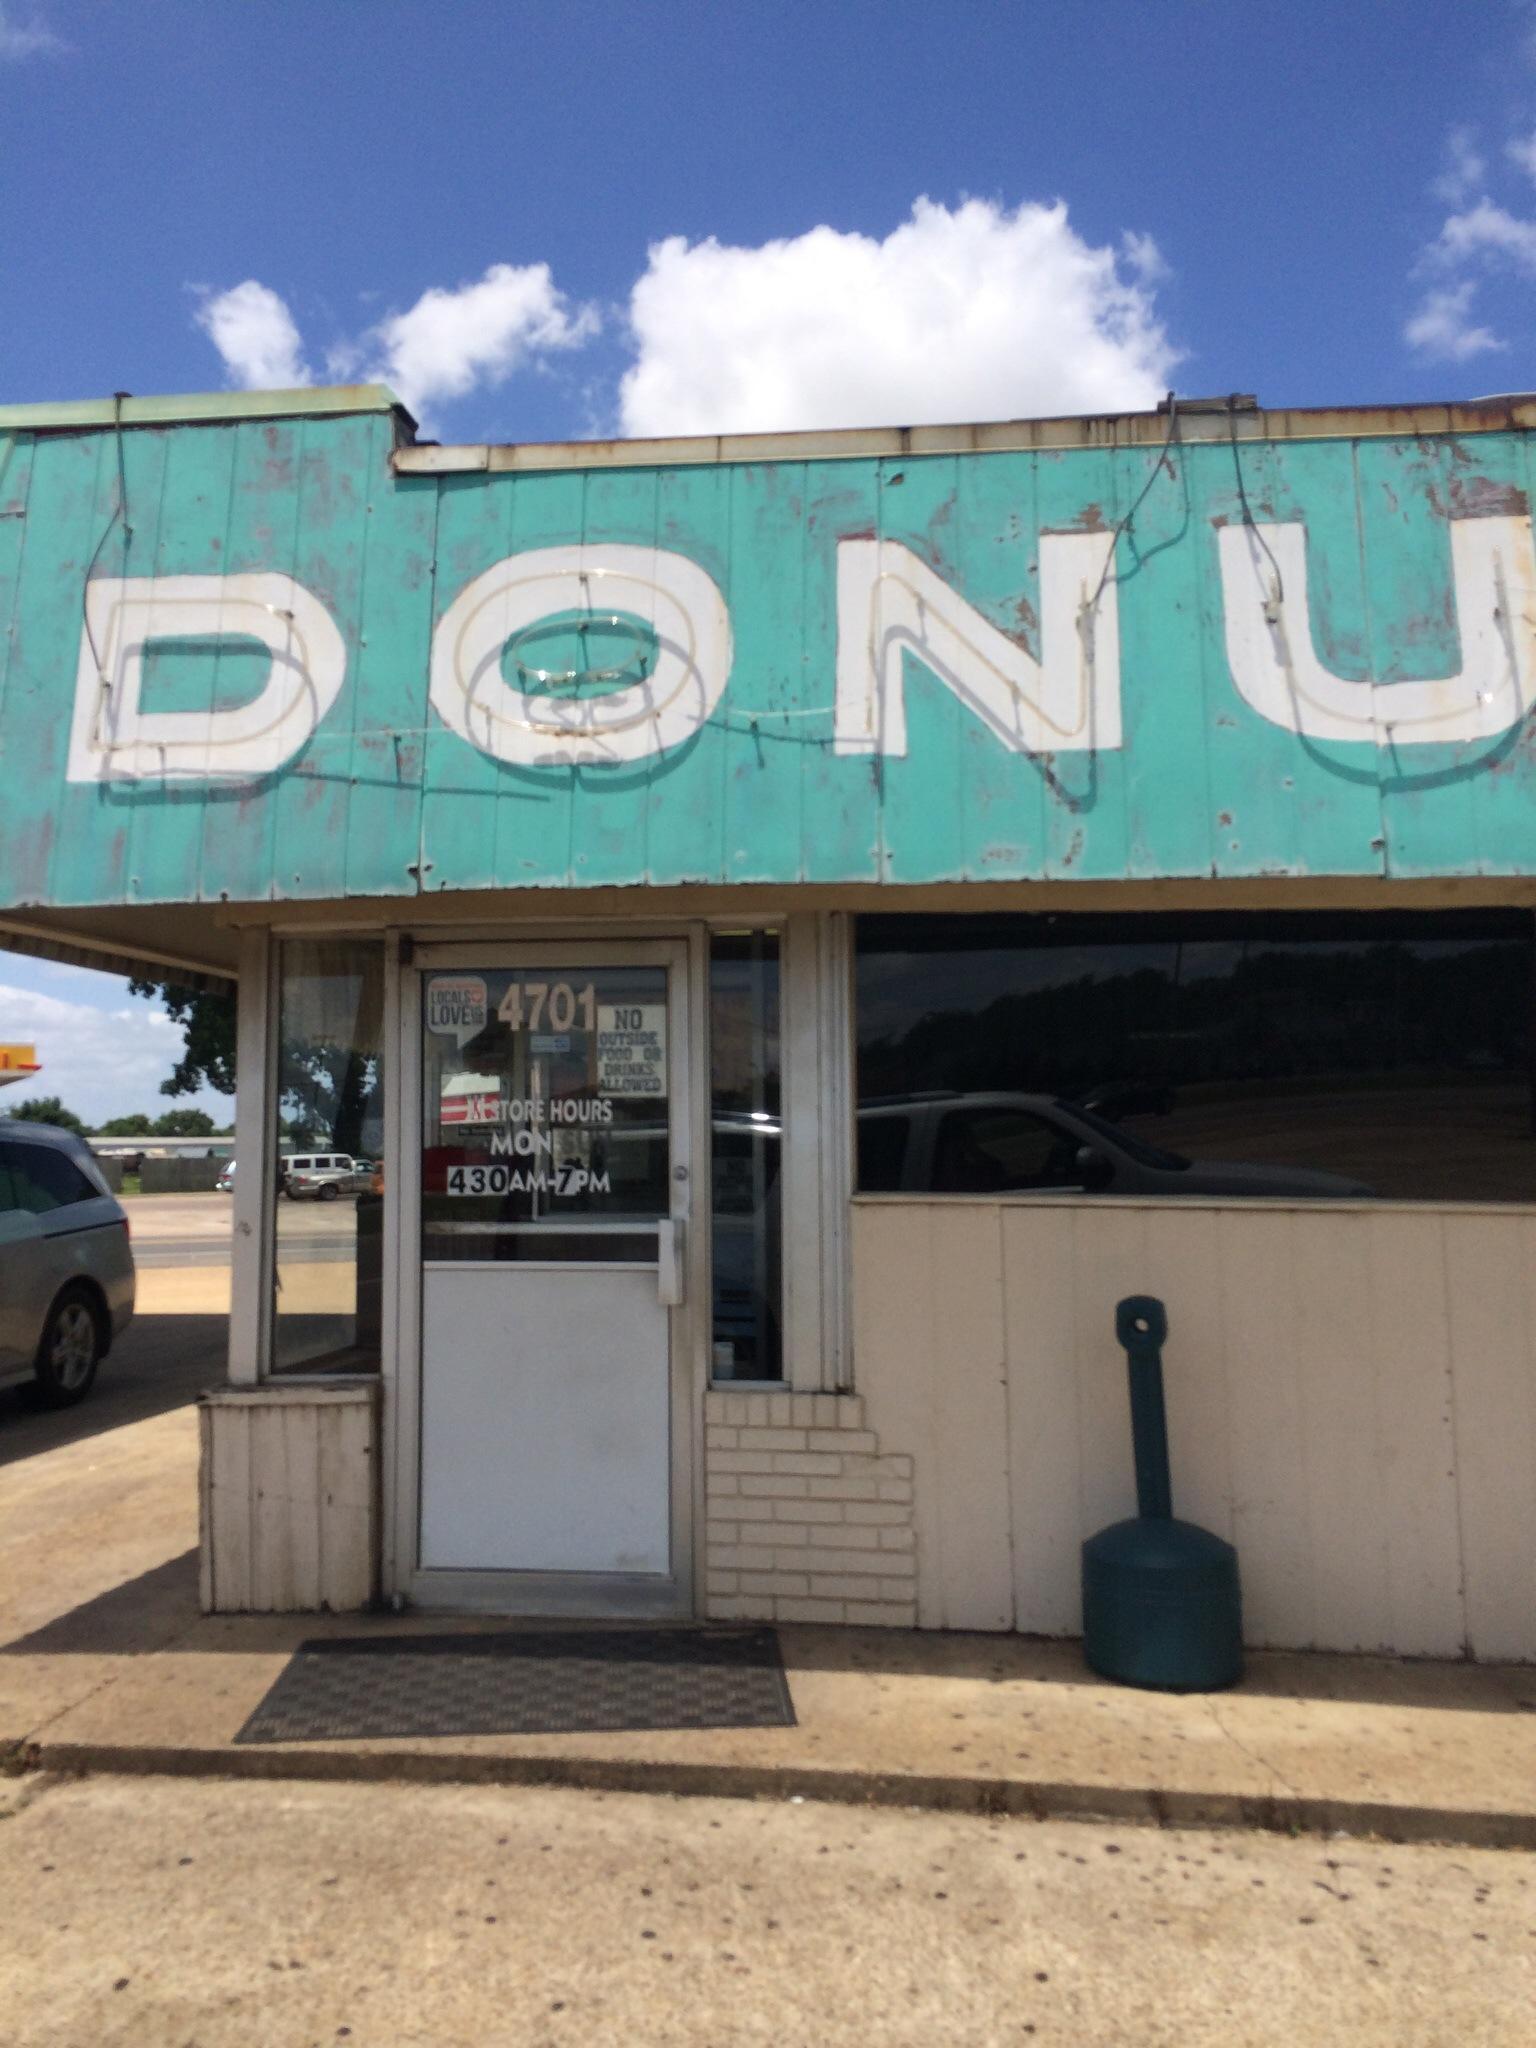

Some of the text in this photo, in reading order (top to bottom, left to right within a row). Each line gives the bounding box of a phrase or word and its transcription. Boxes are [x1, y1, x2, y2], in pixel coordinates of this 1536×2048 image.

[66, 515, 1536, 785] DONU
[431, 1006, 471, 1025] LOVE
[498, 983, 595, 1032] 4701
[614, 1009, 642, 1030] NO
[493, 1099, 544, 1122] STORE
[551, 1099, 613, 1123] HOURS
